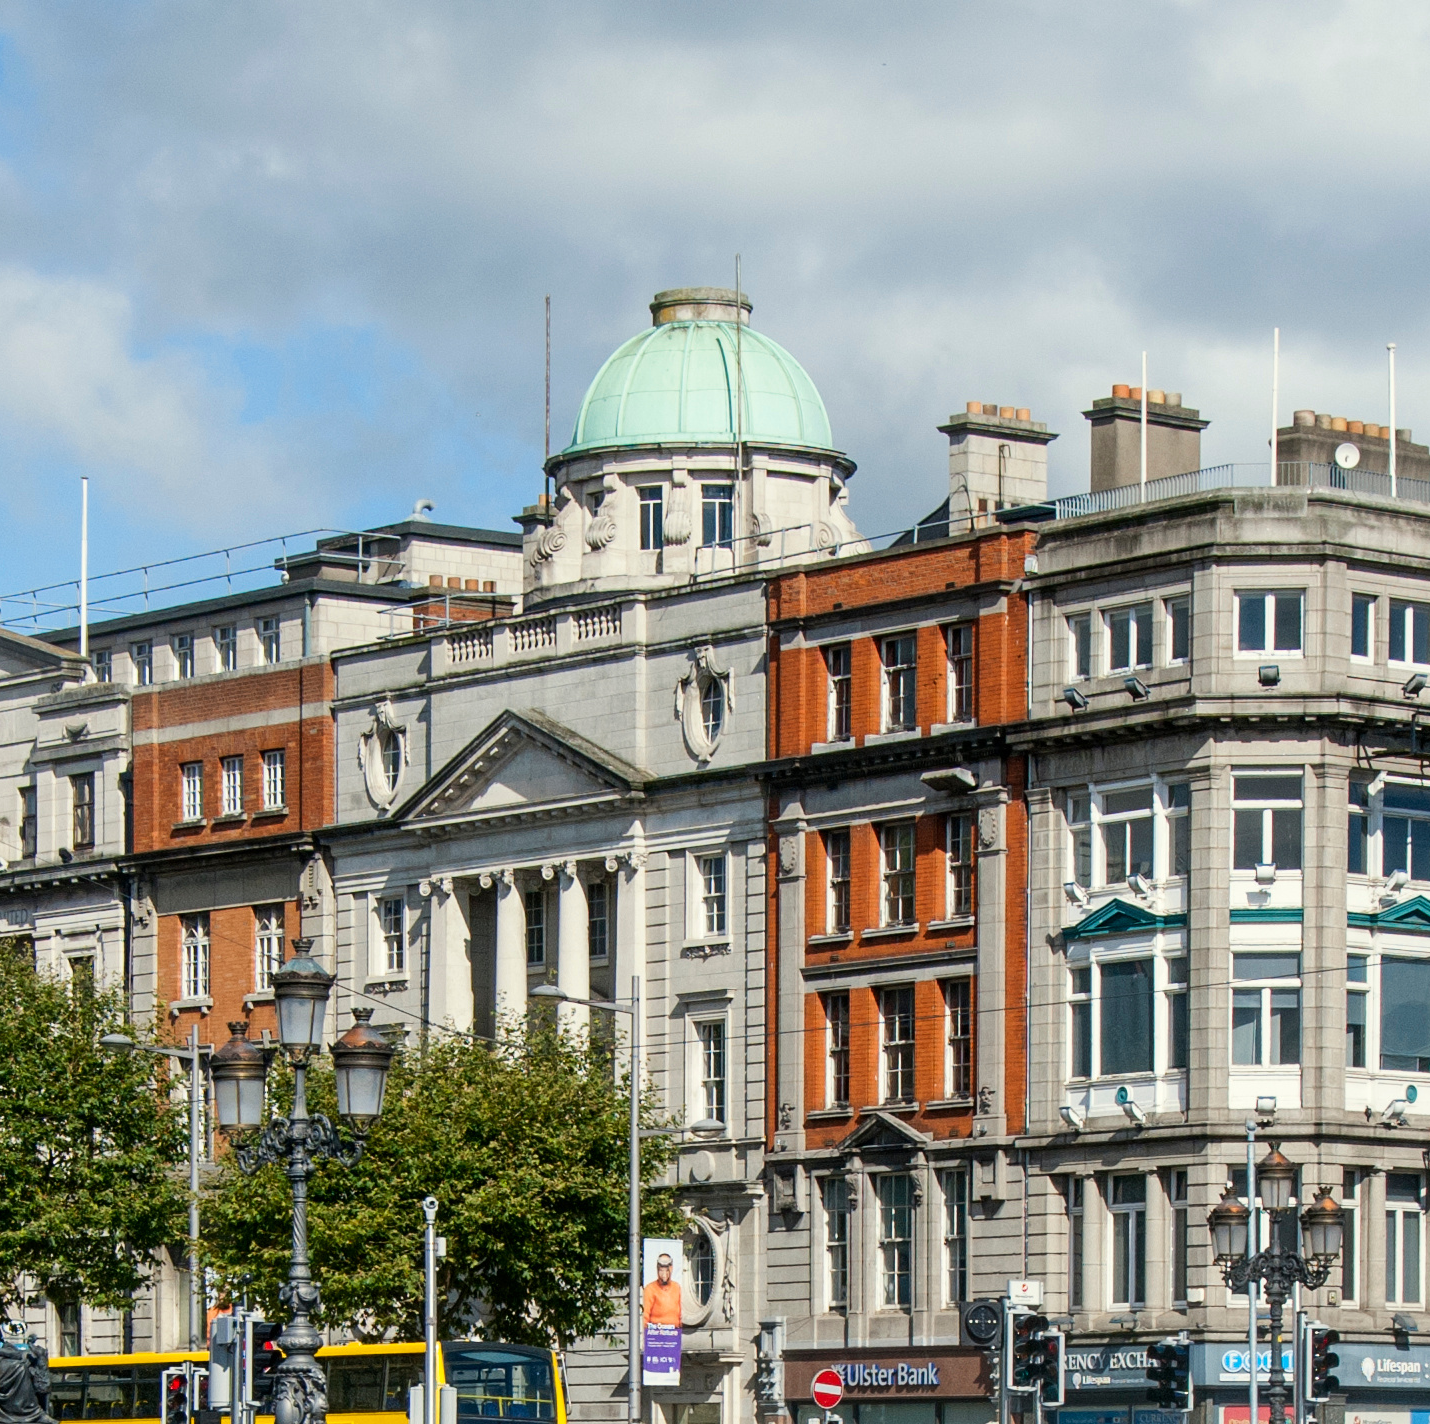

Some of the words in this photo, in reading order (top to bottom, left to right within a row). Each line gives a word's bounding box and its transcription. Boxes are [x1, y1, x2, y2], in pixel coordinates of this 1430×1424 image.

[1064, 1352, 1107, 1370] RENCY
[1109, 1351, 1159, 1369] EXCHA
[1377, 1359, 1421, 1375] Lifespan
[847, 1363, 895, 1386] Ulster
[897, 1362, 939, 1386] Bank
[1139, 1413, 1178, 1423] CURRENC
